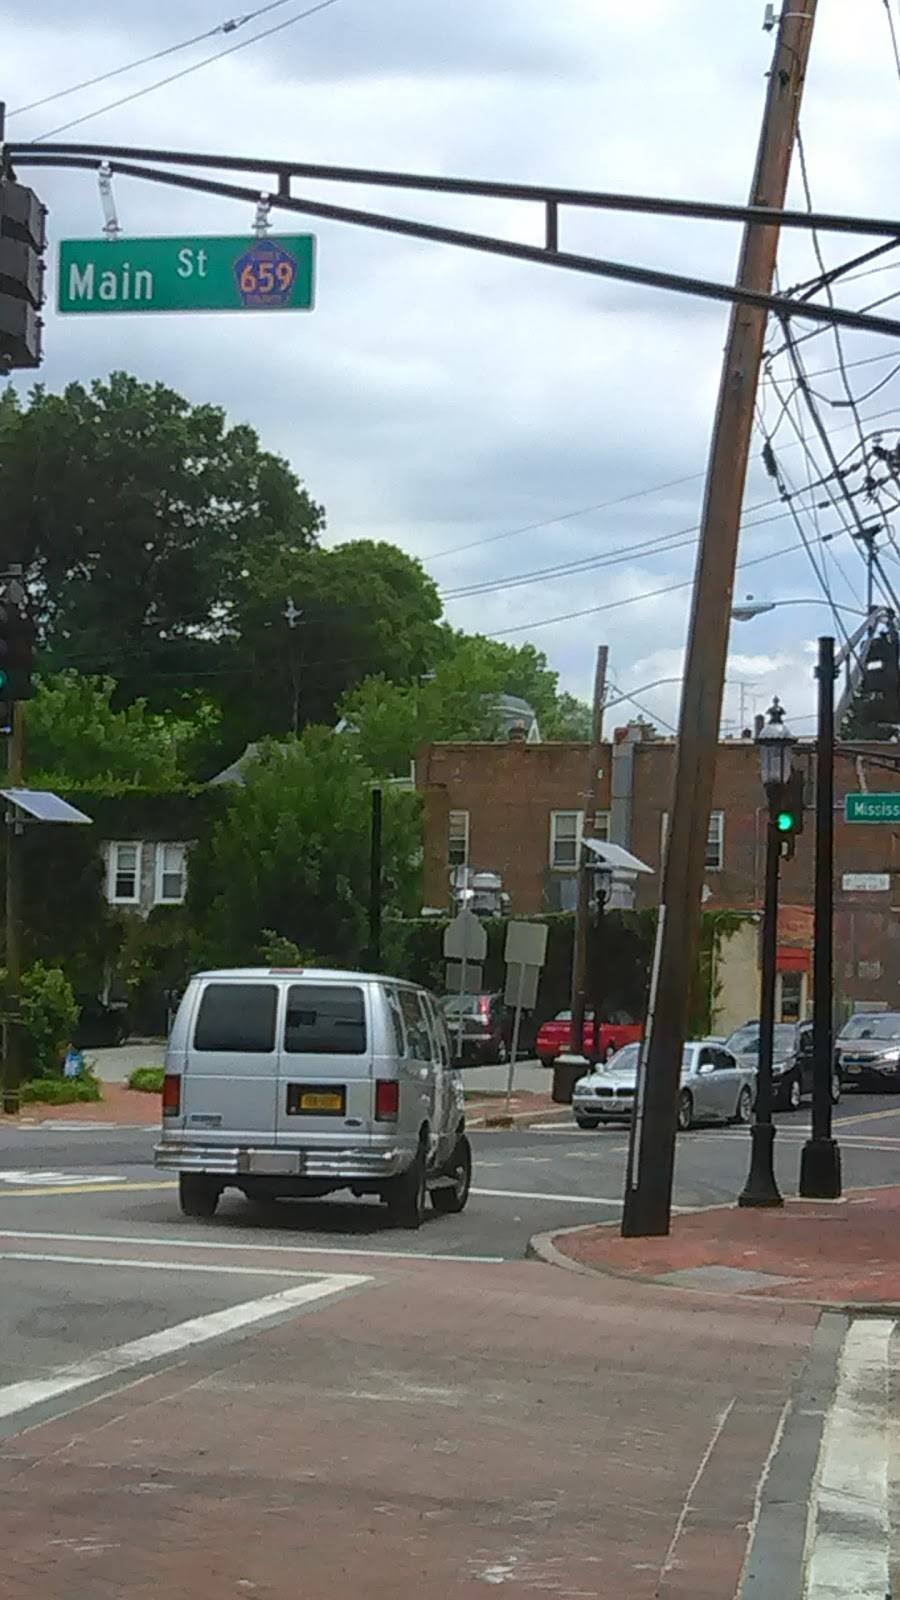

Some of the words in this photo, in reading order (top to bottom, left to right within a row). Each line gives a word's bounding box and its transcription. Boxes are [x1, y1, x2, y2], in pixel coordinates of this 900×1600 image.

[69, 263, 152, 300] Main
[177, 248, 207, 278] St
[240, 262, 293, 293] 659
